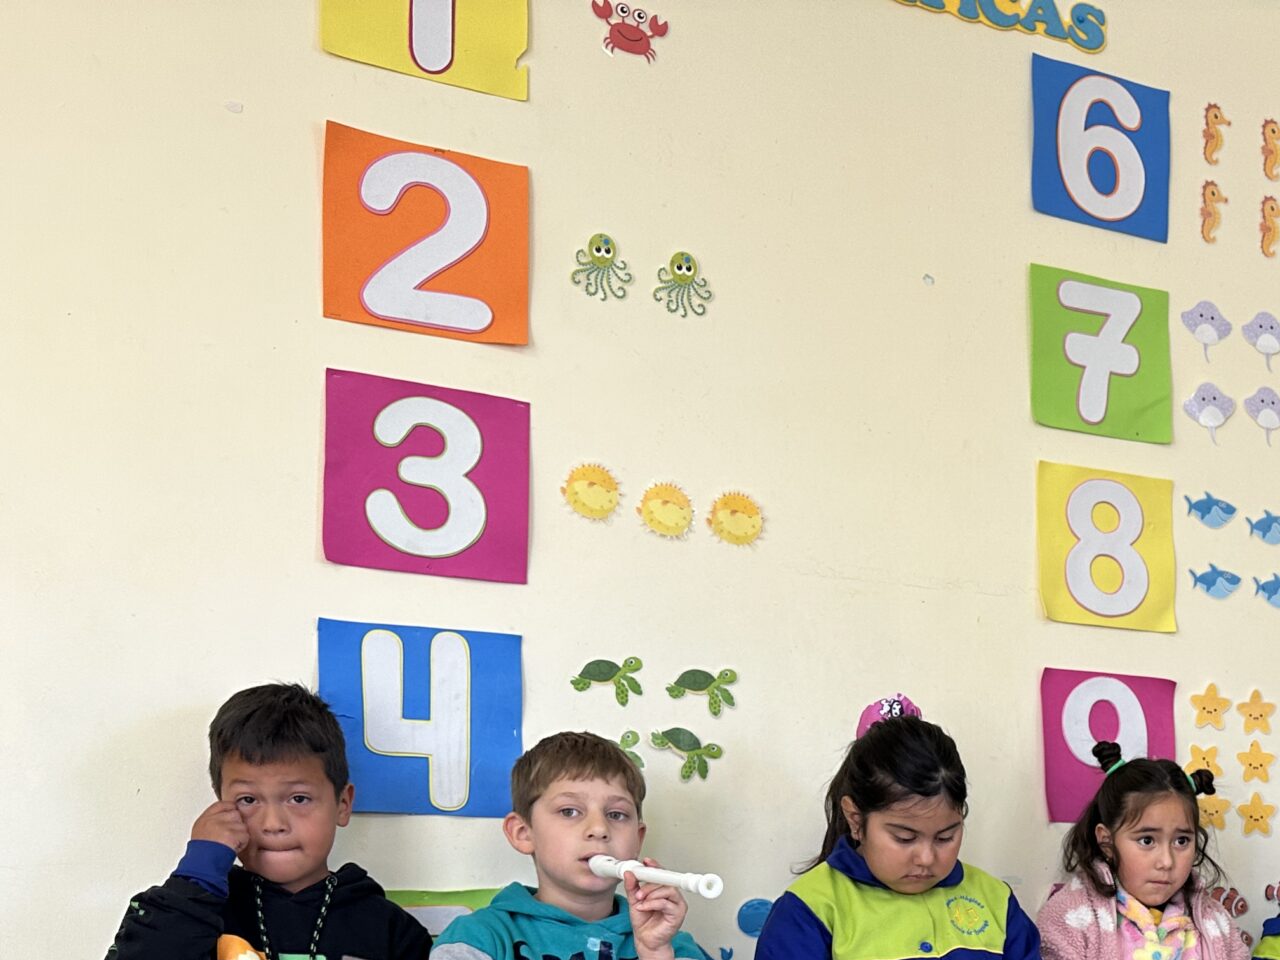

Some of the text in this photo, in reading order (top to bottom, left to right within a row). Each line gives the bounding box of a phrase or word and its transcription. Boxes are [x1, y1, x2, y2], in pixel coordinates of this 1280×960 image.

[1056, 74, 1147, 222] 6
[358, 150, 495, 335] 2
[1058, 280, 1143, 425] 7
[364, 395, 488, 560] 3
[1064, 478, 1150, 618] 8
[361, 628, 471, 812] 4
